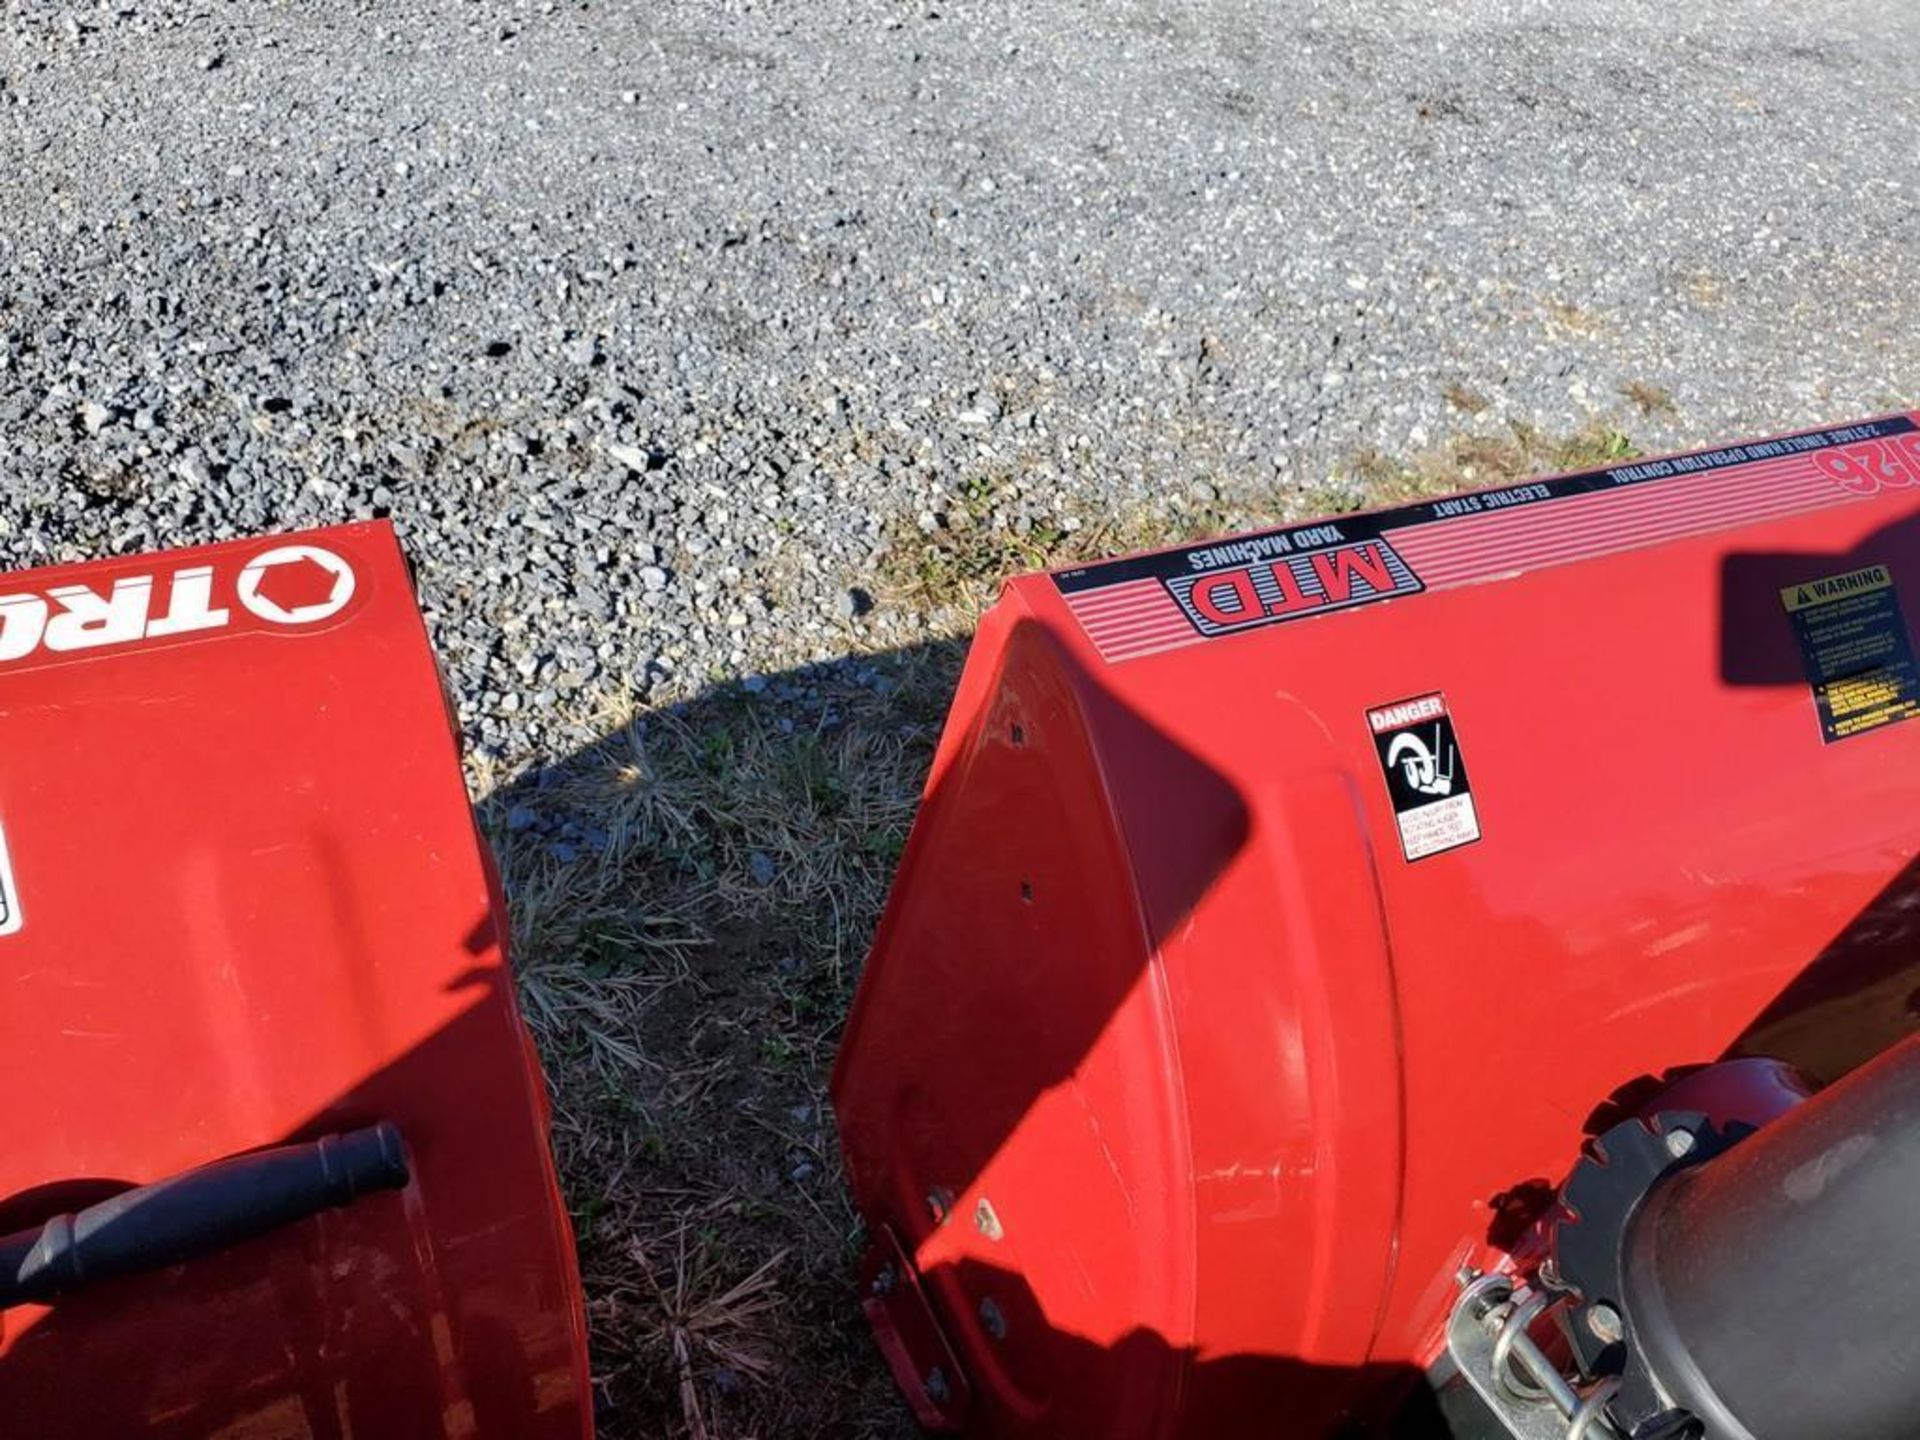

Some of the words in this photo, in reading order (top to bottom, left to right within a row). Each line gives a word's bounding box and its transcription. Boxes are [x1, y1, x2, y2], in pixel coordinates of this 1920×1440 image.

[1784, 433, 1829, 451] SINGLE
[1831, 425, 1880, 443] 2-STAGE
[1671, 449, 1747, 472] OPERATION
[1745, 441, 1785, 459] HAND
[1607, 461, 1674, 483] CONTROL
[1433, 496, 1482, 518] START
[1482, 484, 1551, 508] ELECTRIC
[1297, 525, 1346, 548] YARD
[1188, 534, 1292, 570] MACHINES
[1190, 543, 1397, 625] MTD
[1813, 568, 1885, 598] WARNING
[1369, 698, 1443, 730] DANGER
